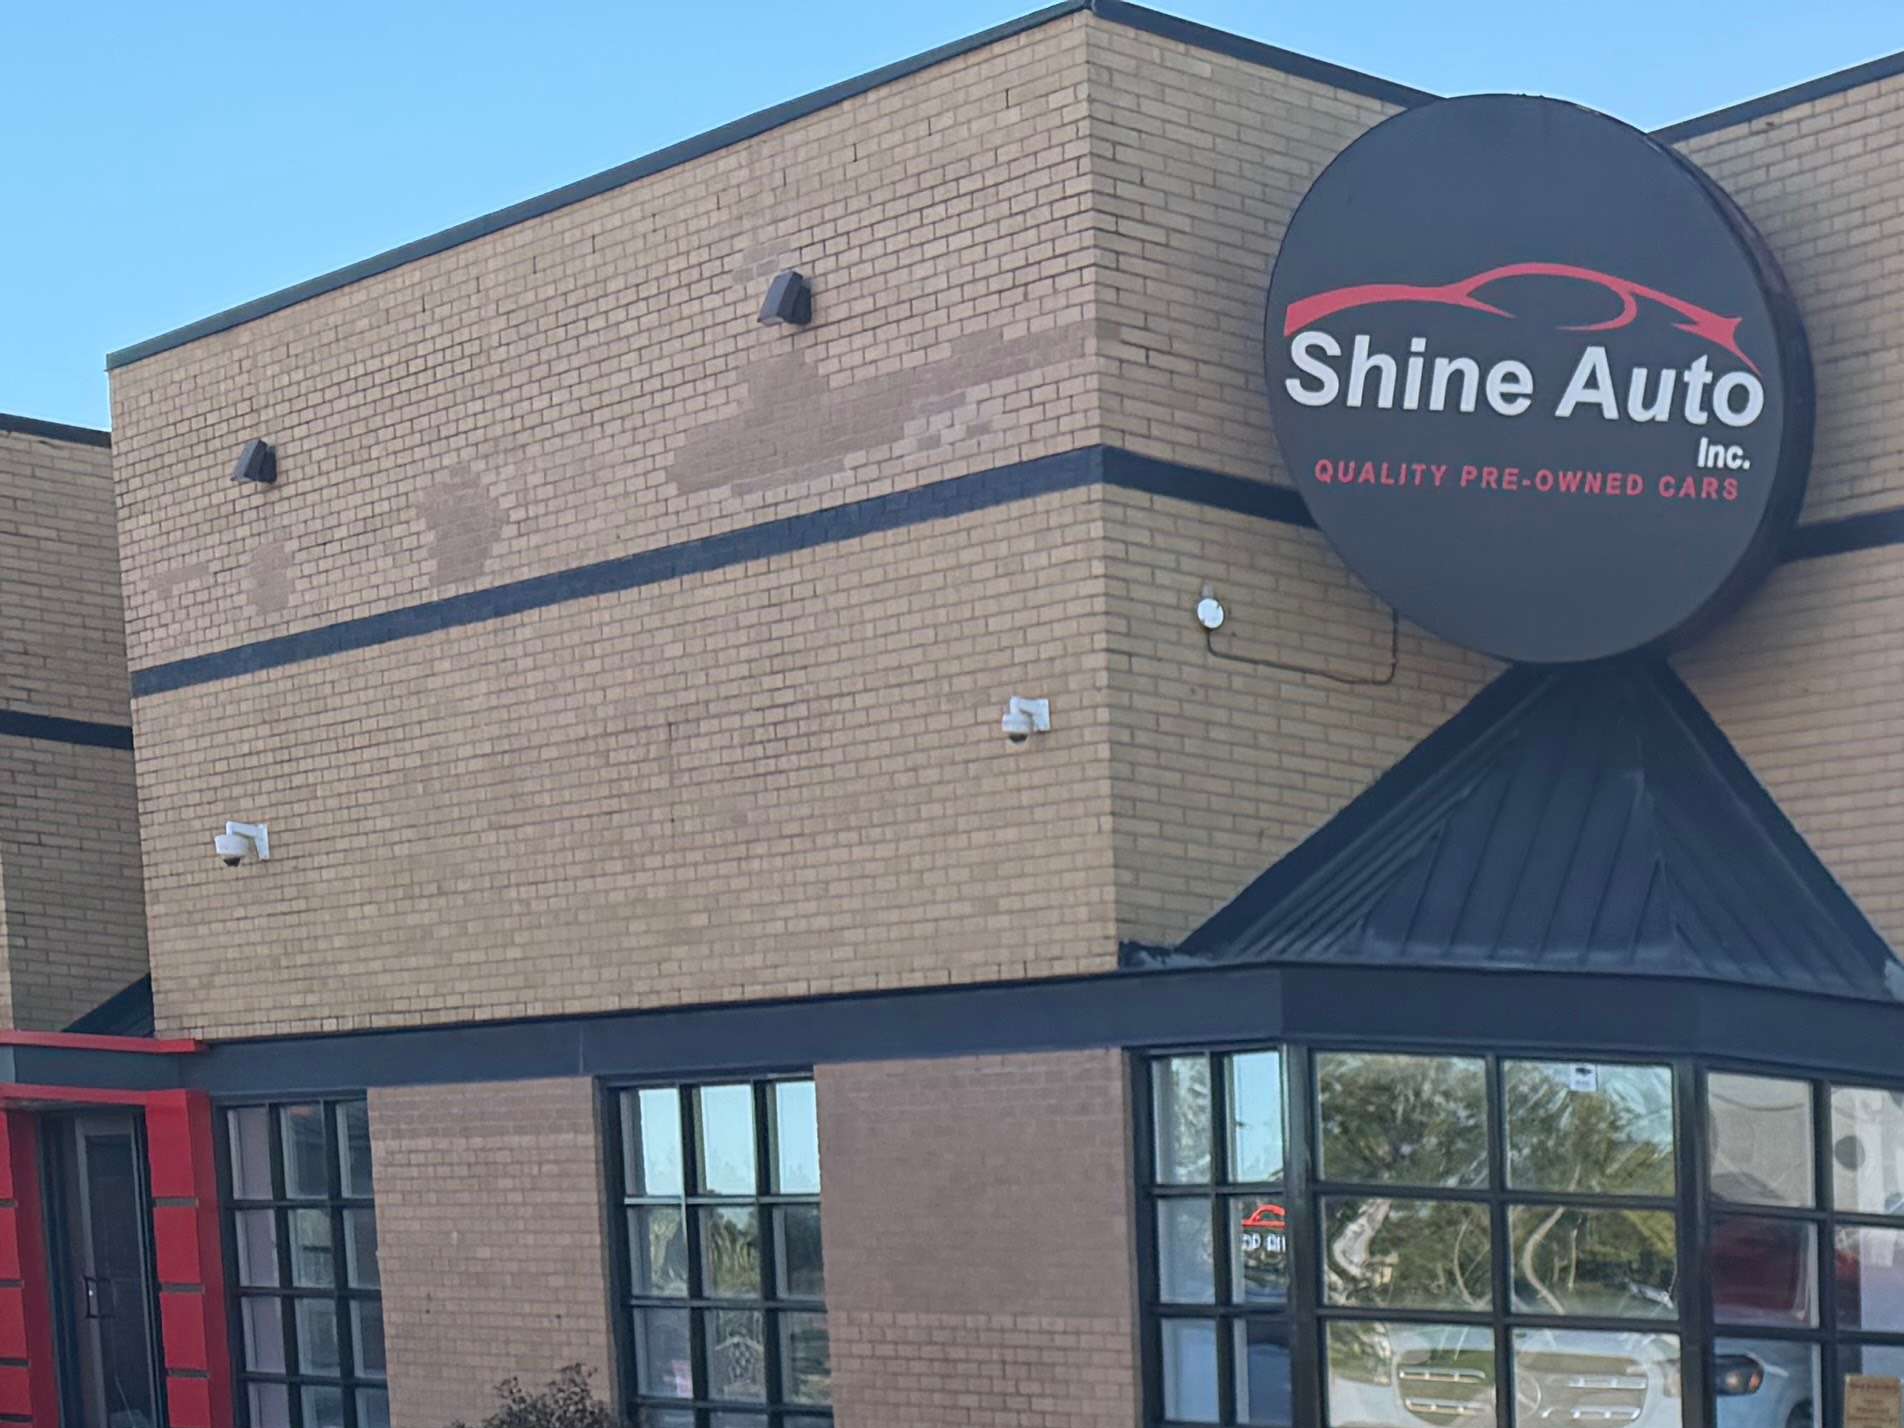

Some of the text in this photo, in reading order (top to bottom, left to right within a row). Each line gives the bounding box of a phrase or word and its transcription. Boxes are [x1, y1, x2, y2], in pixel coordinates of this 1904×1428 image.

[1285, 331, 1764, 427] Shine Auto
[1697, 437, 1751, 470] Inc.
[1314, 459, 1739, 501] QUALITY PRE-OWNED CARS
